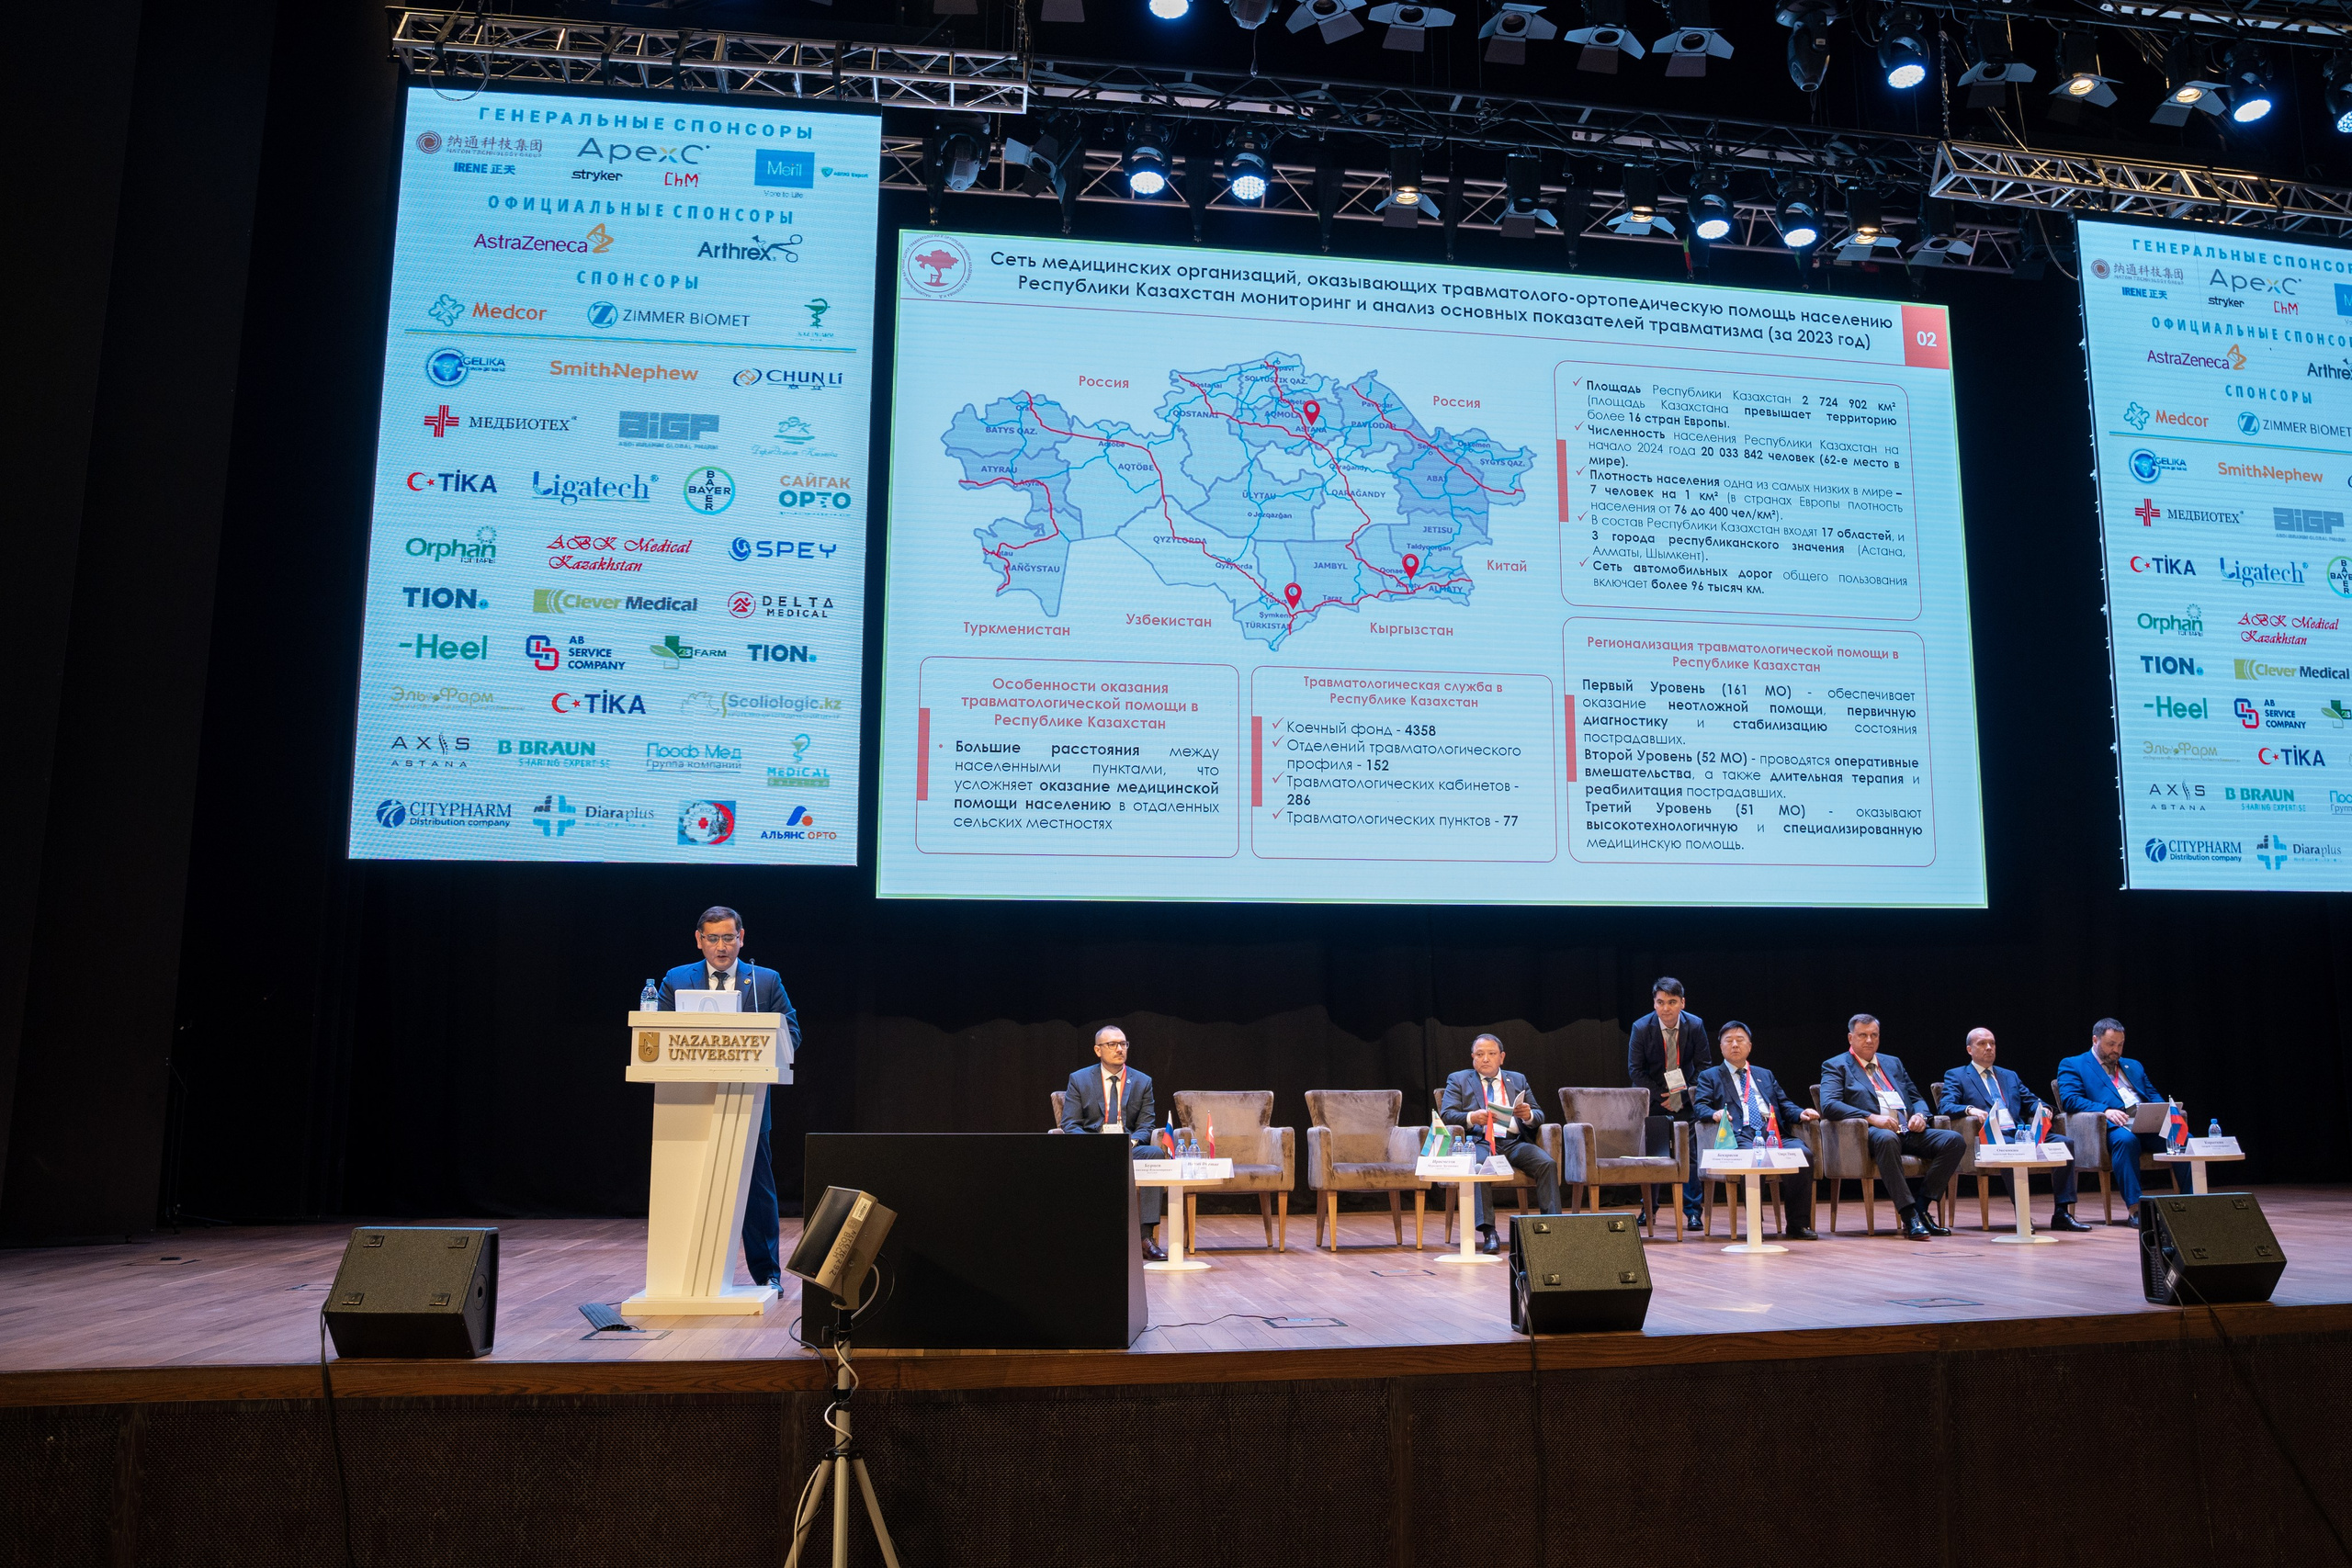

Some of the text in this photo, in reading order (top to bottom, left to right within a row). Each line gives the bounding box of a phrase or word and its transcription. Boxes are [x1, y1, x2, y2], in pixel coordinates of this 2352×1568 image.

[480, 107, 812, 140] ГЕНЕРАЛЬНЫЕ СПОНСОРЫ
[453, 162, 488, 174] IRENE
[571, 169, 623, 182] stryker
[767, 160, 802, 177] Meril
[488, 195, 793, 224] ОФИЦИАЛЬНЫЕ СПОНСОРЫ
[472, 232, 589, 253] AstraZeneca
[697, 238, 772, 261] Arthrex
[576, 270, 698, 290] СПОНСОРЫ
[990, 251, 1894, 329] Сеть медицинских организаций, оказывающих травматолого-ортопедическую помощь населению
[2208, 296, 2245, 308] stryker
[471, 300, 548, 322] Medcor
[622, 309, 750, 326] ZIMMER BIOMET
[1018, 274, 1871, 352] Республики Казахстан мониторинг и анализ основных показателей травматизма (за 2023 год)
[1917, 331, 1937, 347] 02
[2147, 350, 2230, 369] AstraZeneca
[1080, 376, 1128, 388] Россия
[1433, 396, 1480, 408] Россия
[1586, 379, 1896, 412] Площадь Республики Казахстан 2 724 902 км²
[2225, 384, 2312, 404] СПОНСОРЫ
[469, 415, 571, 431] МЕДБИОТЕХ
[1587, 409, 1730, 429] более 16 стран Европы.
[2155, 410, 2209, 427] Medcor
[2263, 420, 2351, 436] ZIMMER BIOMET
[780, 473, 850, 489] САЙГАК
[687, 484, 732, 497] BAYER
[778, 490, 852, 510] ОРТО
[2167, 509, 2240, 524] МЕДБИОТЕХ
[404, 536, 497, 563] Orphan
[547, 535, 693, 555] ABK Medical
[755, 541, 837, 559] SPEY
[548, 554, 643, 574] Kazakhstan
[1487, 560, 1526, 571] Китай
[1593, 578, 1765, 594] включает более 96 тысяч км.
[561, 594, 699, 613] Clever Medical
[765, 608, 829, 619] MEDICAL
[1126, 614, 1211, 627] Узбекистан
[964, 622, 1069, 636] Туркменистан
[1371, 623, 1453, 637] Кыргызстан
[2241, 630, 2307, 645] Kazakhstan
[568, 636, 585, 646] AB
[1587, 636, 1899, 660] Регионализация травматологической помощи в
[567, 647, 613, 659] SERVICE
[567, 660, 627, 671] COMPANY
[1672, 655, 1821, 672] Республике Казахстан
[991, 677, 1169, 694] Особенности оказания
[1303, 675, 1503, 694] Травматологическая служба в
[1582, 678, 1916, 702] Первый Уровень (161 МО) обеспечивает
[960, 696, 1199, 713] травматологической помощи в
[1329, 692, 1478, 708] Республике Казахстан
[994, 713, 1166, 730] Республике Казахстан
[1286, 721, 1437, 738] Коечный фонд 4358
[498, 739, 596, 757] B BRAUN
[956, 739, 1220, 761] Большие расстояния между
[1286, 739, 1521, 757] Отделений травматологического
[390, 759, 469, 769] ASTANA
[955, 761, 1220, 777] населенными пунктами, что
[1286, 759, 1390, 773] профиля 152
[954, 779, 1219, 795] усложняет оказание медицинской
[1286, 774, 1511, 792] Травматологических кабинетов
[954, 798, 1220, 814] помощи населению в отдаленных
[1286, 793, 1311, 807] 286
[408, 801, 513, 818] CITYPHARM
[583, 804, 655, 821] Diaraplus
[409, 817, 512, 829] Distribution company
[953, 817, 1114, 830] сельских местностях
[1286, 810, 1519, 829] Травматологических пунктов 77
[760, 830, 837, 841] АЛЬЯНС ОРТО
[1586, 838, 1745, 852] медицинскую помощь.
[2169, 840, 2242, 853] CITYPHARM
[668, 1034, 770, 1046] NAZARBAYEV
[668, 1049, 763, 1061] UNIVERSITY
